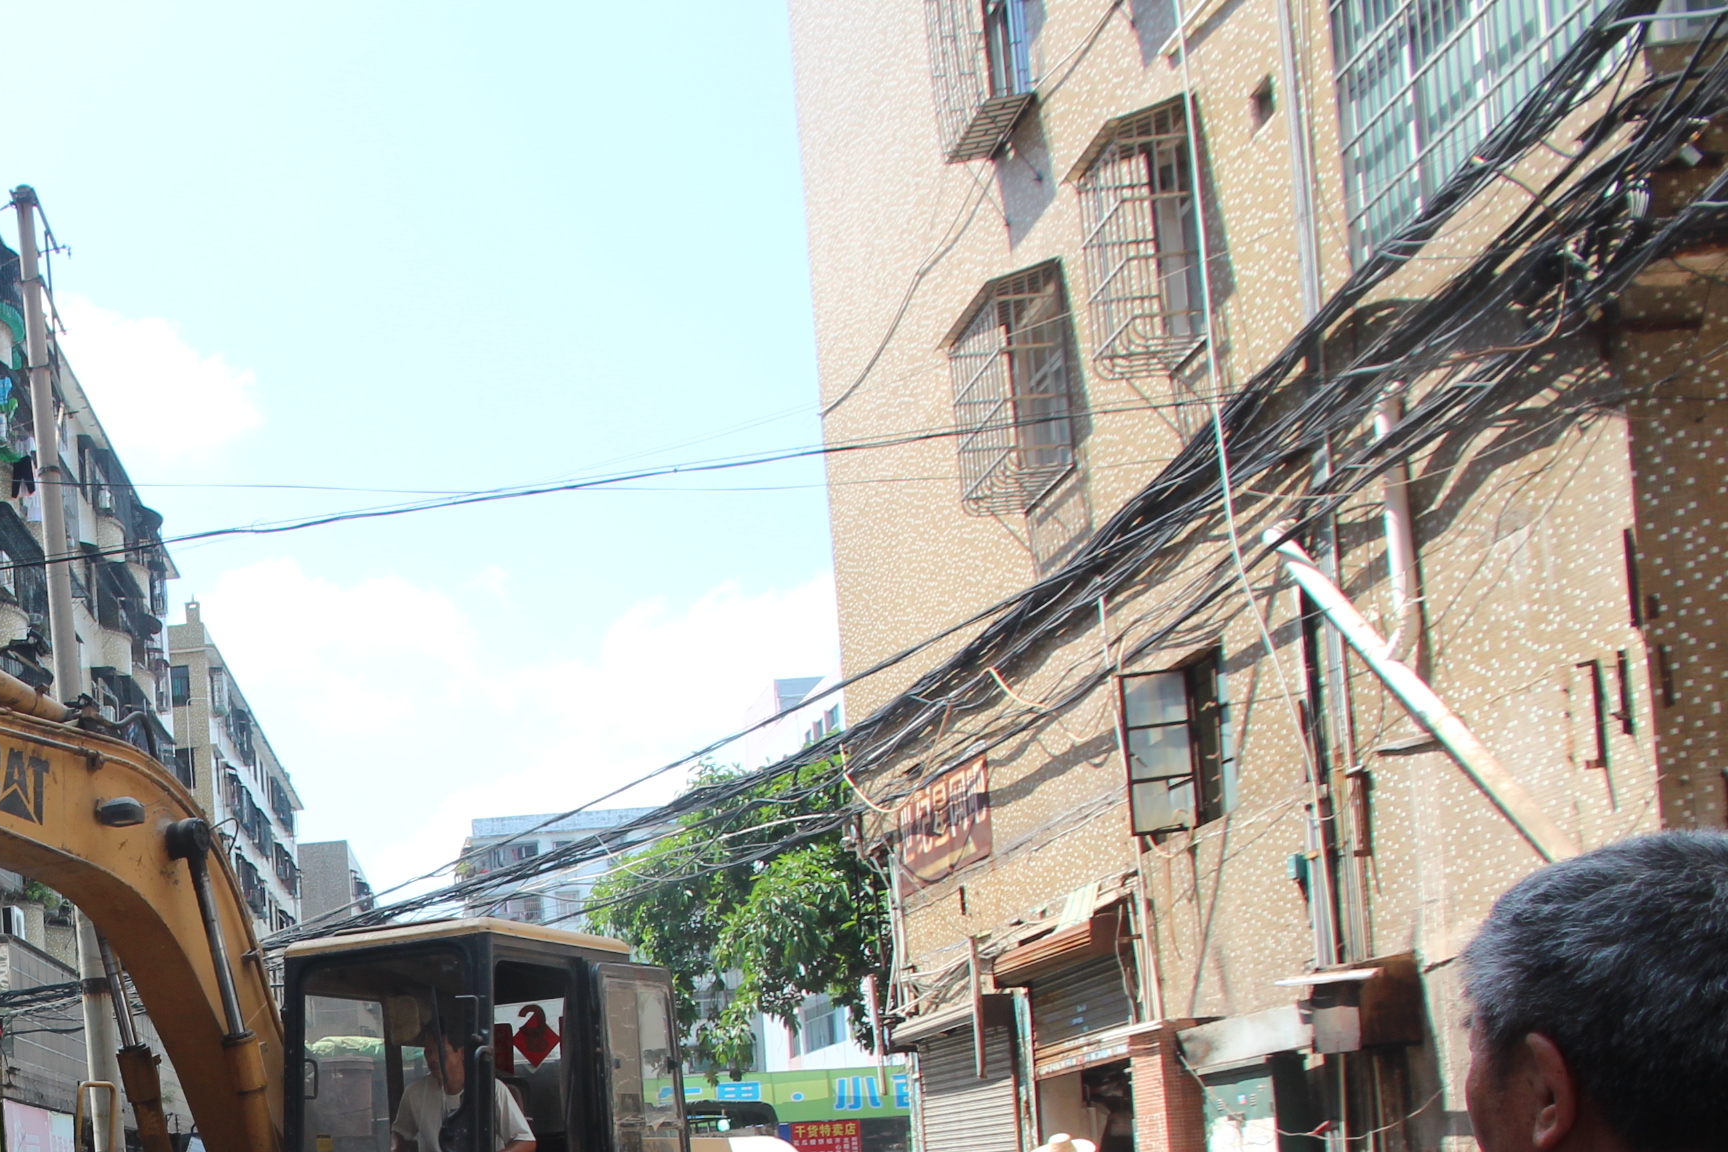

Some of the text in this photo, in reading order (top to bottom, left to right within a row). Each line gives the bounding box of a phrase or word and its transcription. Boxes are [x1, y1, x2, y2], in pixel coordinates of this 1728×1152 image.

[794, 1122, 856, 1138] 干货特卖店
